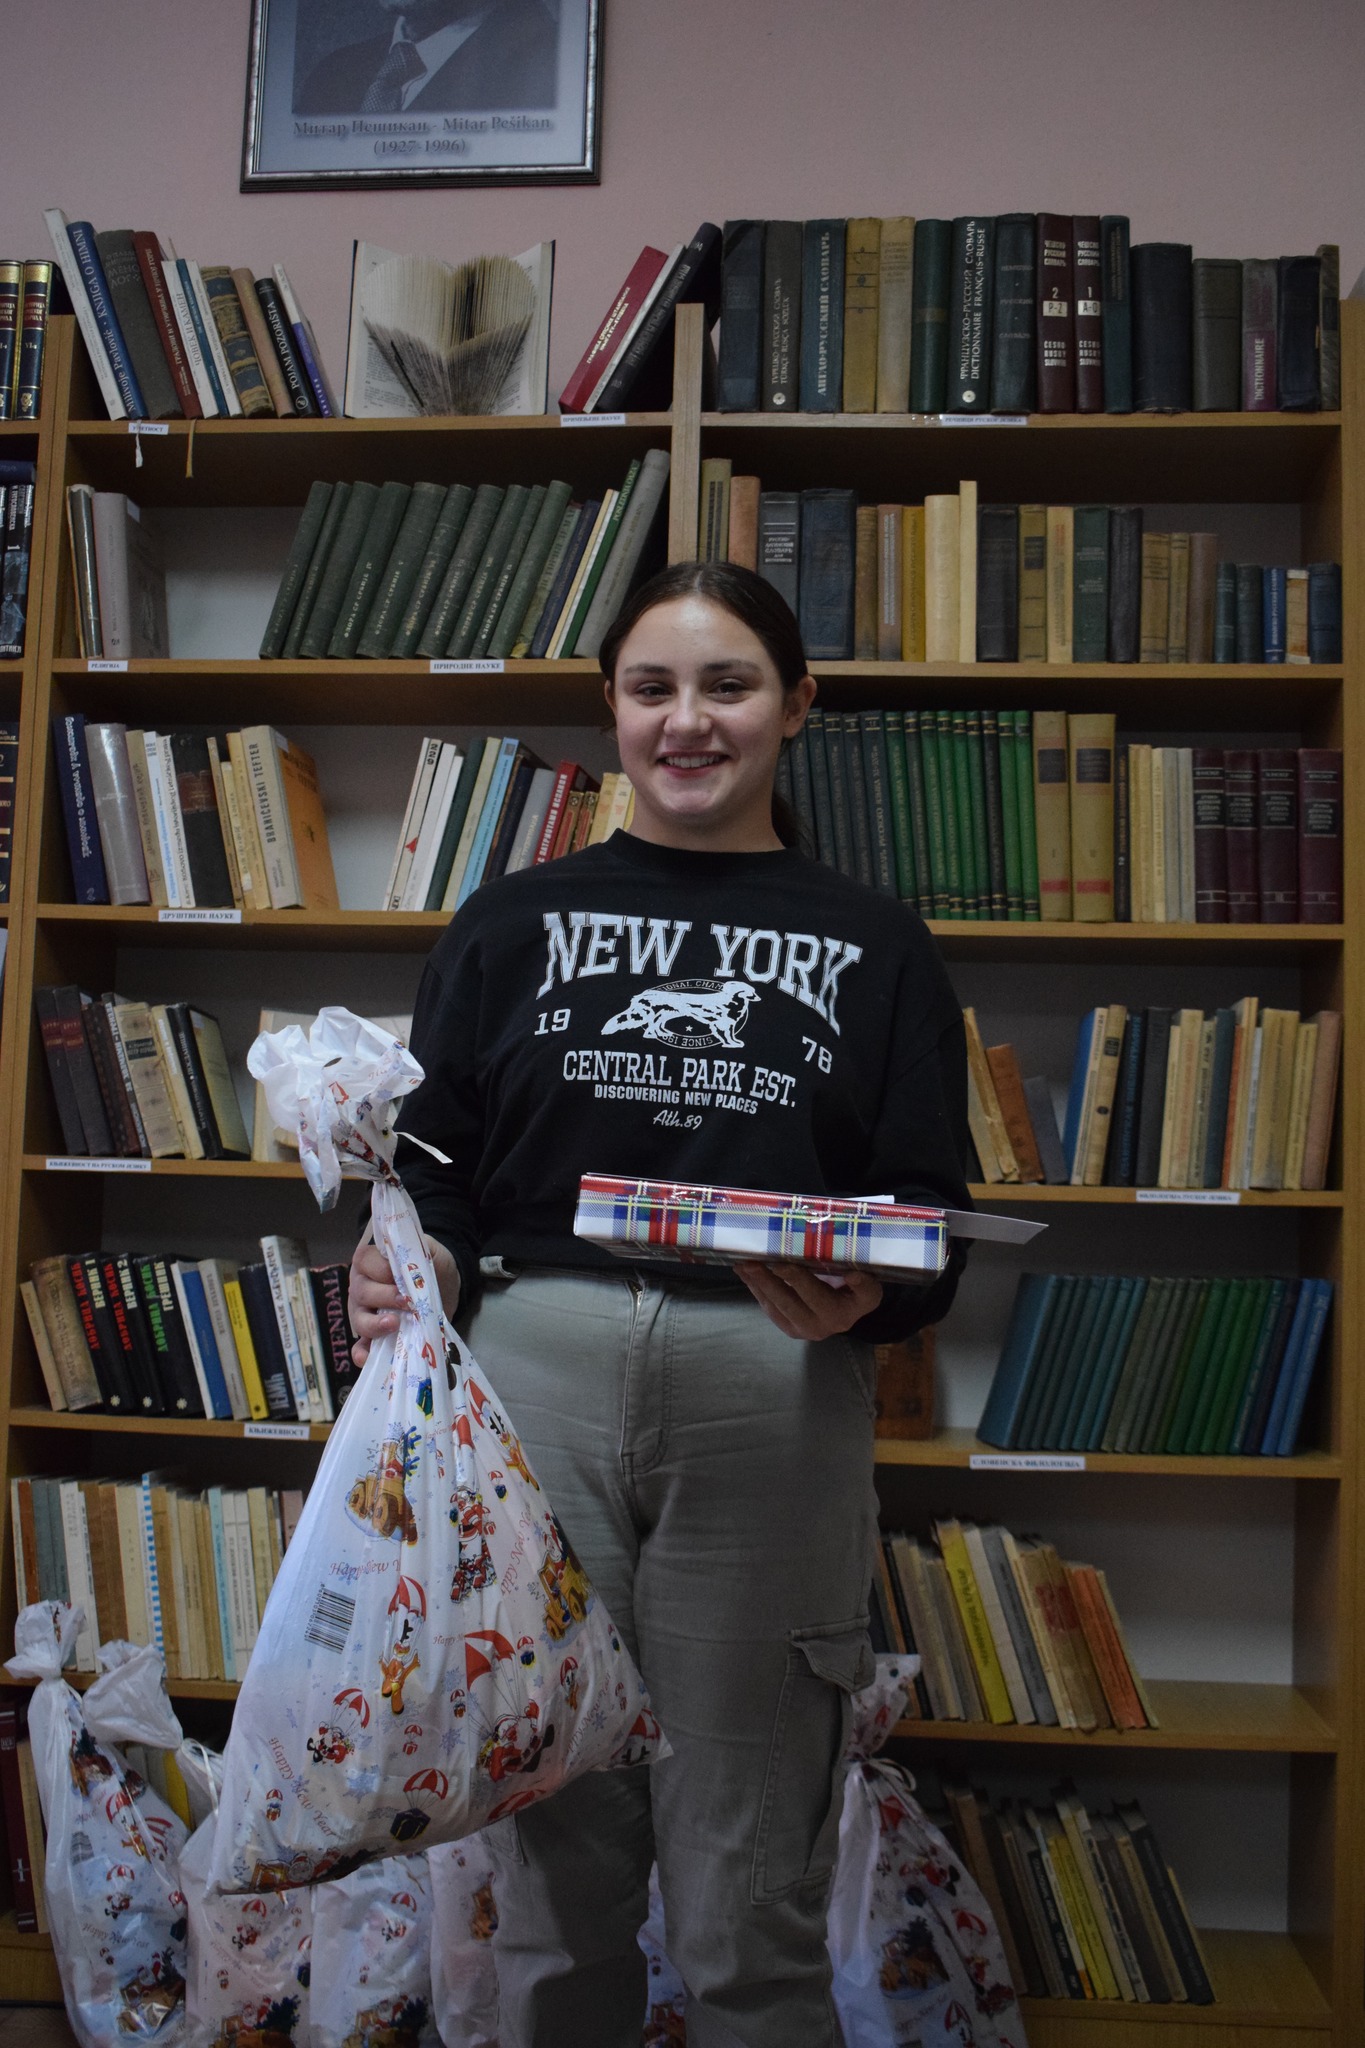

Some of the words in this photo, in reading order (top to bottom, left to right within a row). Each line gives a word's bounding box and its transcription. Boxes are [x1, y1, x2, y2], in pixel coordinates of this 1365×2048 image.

[294, 122, 346, 137] Митар
[352, 120, 427, 133] Пешикан
[442, 118, 486, 130] Mitar
[491, 114, 550, 129] Pešikan
[73, 229, 90, 265] HIMNI
[819, 231, 830, 291] СЛОВАРЬ
[964, 220, 974, 263] СЛОВАРЬ
[84, 266, 94, 276] O
[89, 275, 108, 319] KNJIGA
[1052, 286, 1059, 299] 2
[1087, 286, 1092, 299] 1
[265, 302, 289, 354] POZORIŠTA
[971, 312, 981, 378] DICTIONNAIRE
[103, 329, 123, 370] Pavlović
[1254, 338, 1264, 400] DICTIONNAIRE
[119, 370, 136, 413] Milivoje
[282, 355, 300, 389] POJAM
[249, 743, 263, 778] TEFTER
[256, 781, 276, 843] BRANIČEVSKI
[162, 912, 206, 920] ДРУШТВЕНЕ
[209, 912, 234, 920] НАУКЕ
[536, 911, 692, 1000] NEW
[710, 924, 863, 1037] YORK
[534, 1008, 571, 1036] 19
[801, 1036, 833, 1074] 78
[562, 1050, 673, 1085] CENTRAL
[682, 1058, 746, 1094] PARK
[751, 1066, 797, 1108] EST.
[594, 1083, 681, 1105] DISCOVERING
[684, 1091, 714, 1107] NEW
[715, 1093, 759, 1116] PLACES
[652, 1109, 703, 1131] Ath.89
[70, 1261, 87, 1296] ЋОСИЋ
[103, 1262, 120, 1298] ЋОСИЋ
[117, 1258, 127, 1267] 2
[139, 1263, 157, 1299] ЋОСИЋ
[86, 1268, 105, 1308] ВЕРНИК
[119, 1267, 137, 1309] ВЕРНИК
[153, 1260, 174, 1311] ГРЕШНИК
[78, 1300, 98, 1351] ДОБРИЦА
[111, 1300, 132, 1351] ДОБРИЦА
[147, 1302, 168, 1353] ДОБРИЦА
[322, 1270, 350, 1373] STENDAL
[248, 1427, 303, 1437] КЊИЖЕВНОСТ
[269, 1737, 294, 1779] Happy
[313, 1809, 339, 1837] Year
